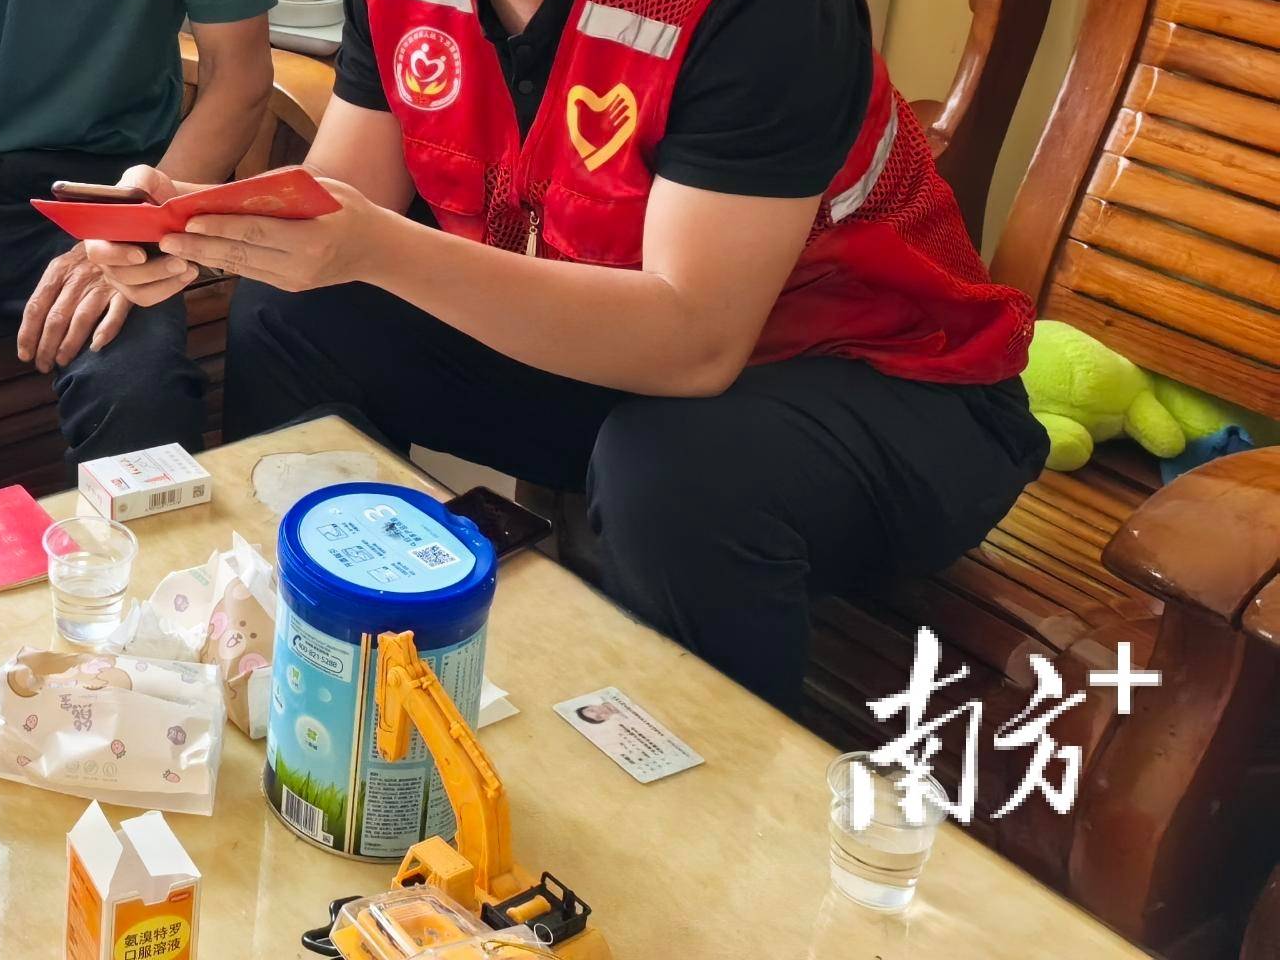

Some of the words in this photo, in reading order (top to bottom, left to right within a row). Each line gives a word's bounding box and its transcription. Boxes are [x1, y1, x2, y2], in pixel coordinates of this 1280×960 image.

[363, 504, 398, 523] 3
[124, 922, 182, 947] 氨溴特罗
[124, 938, 181, 960] 口服溶液
